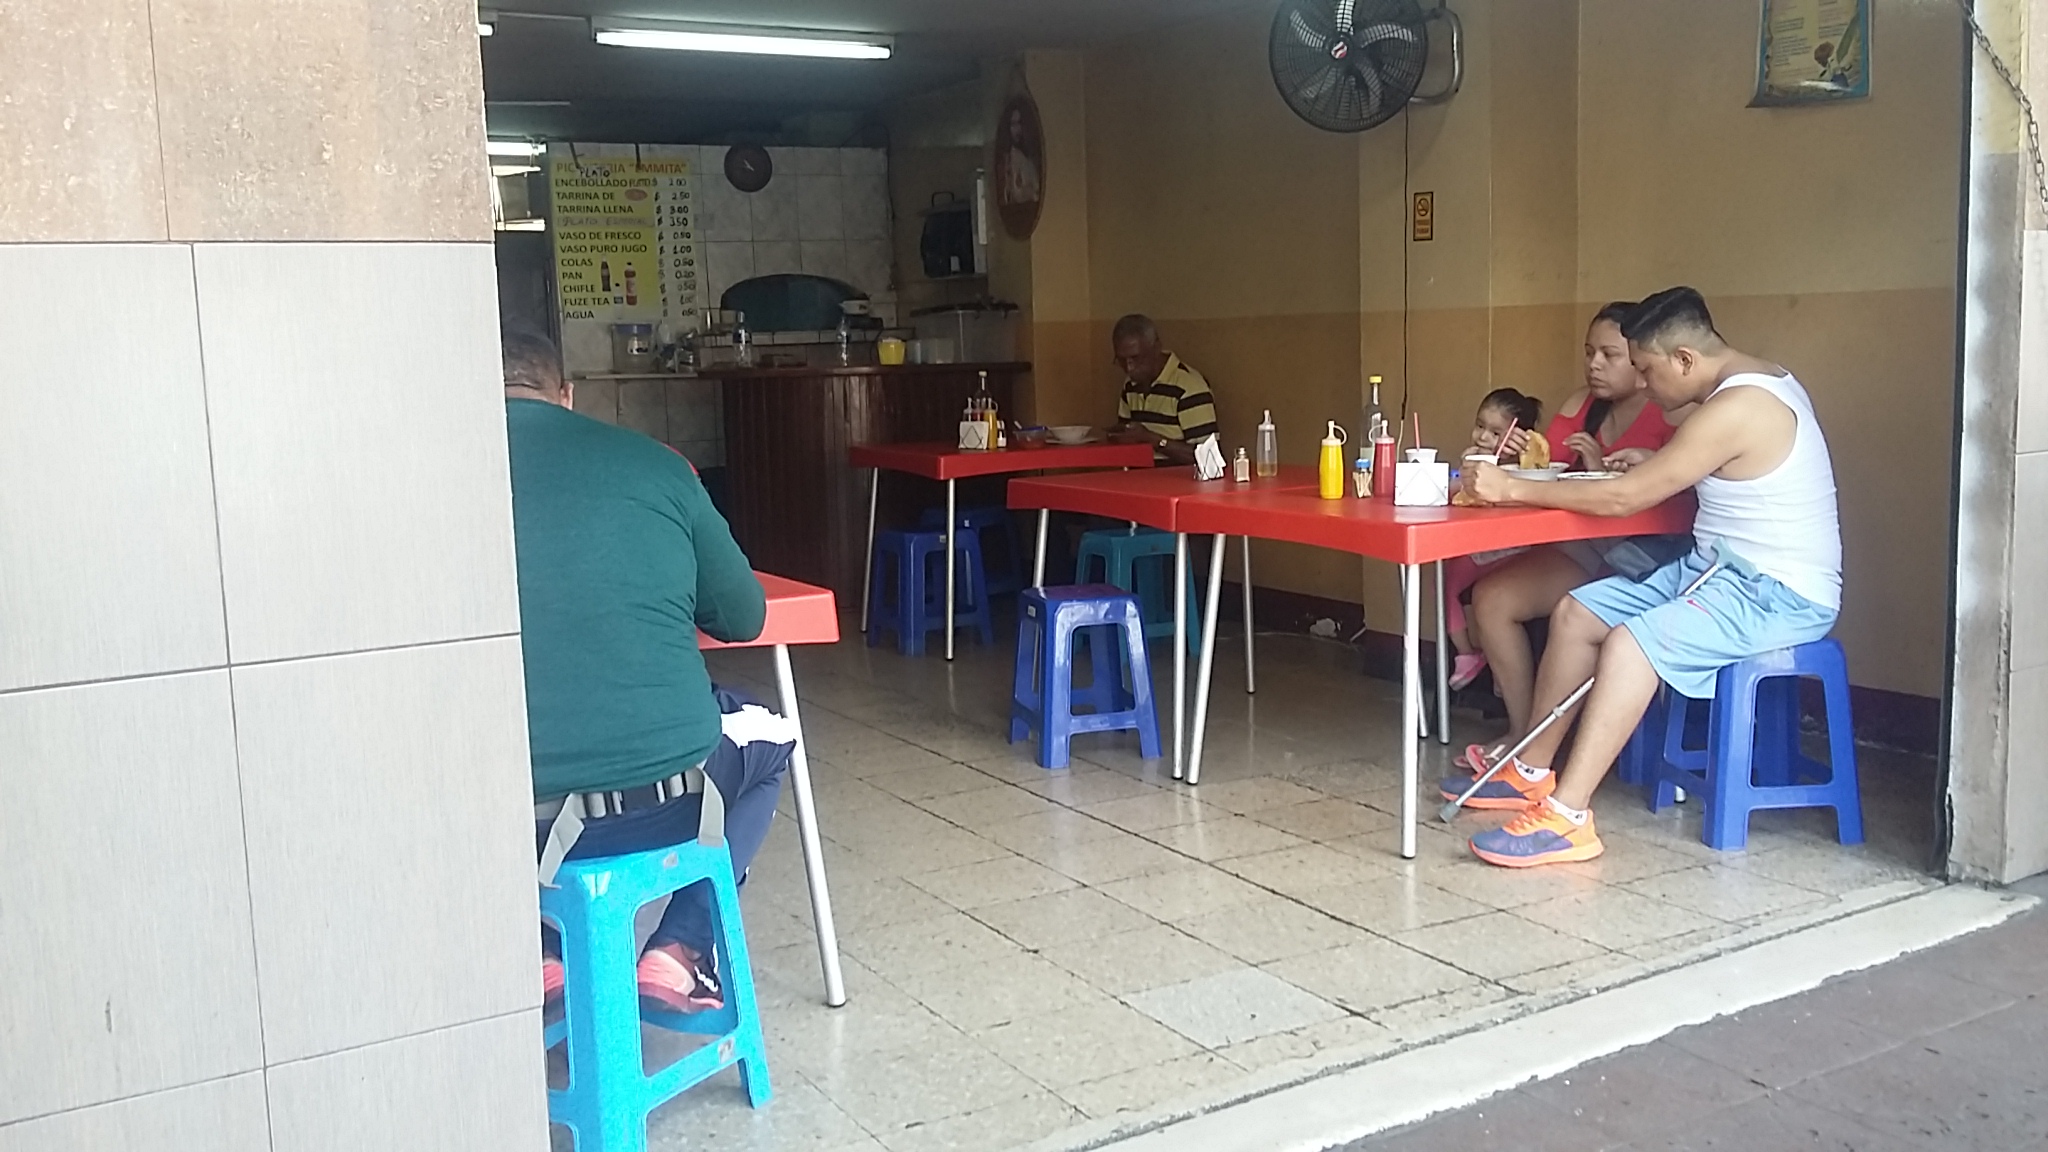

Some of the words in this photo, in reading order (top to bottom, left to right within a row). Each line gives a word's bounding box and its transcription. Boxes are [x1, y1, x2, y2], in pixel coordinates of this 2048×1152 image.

[579, 166, 611, 178] PLATO
[554, 178, 628, 187] ENCEBOLLADO
[556, 192, 600, 200] TARRINA
[602, 192, 614, 200] DE
[557, 205, 601, 214] TARRINA
[603, 205, 634, 213] LLENA
[558, 232, 586, 240] VASO
[589, 232, 602, 240] DE
[605, 232, 642, 240] FRESCO
[560, 245, 587, 254] VASO
[590, 244, 618, 253] PURO
[620, 244, 648, 253] JUGO
[561, 258, 593, 266] COLAS
[563, 284, 595, 293] CHIFLE
[564, 298, 589, 306] FUZE
[592, 297, 610, 305] TEA
[565, 311, 594, 319] AGUA
